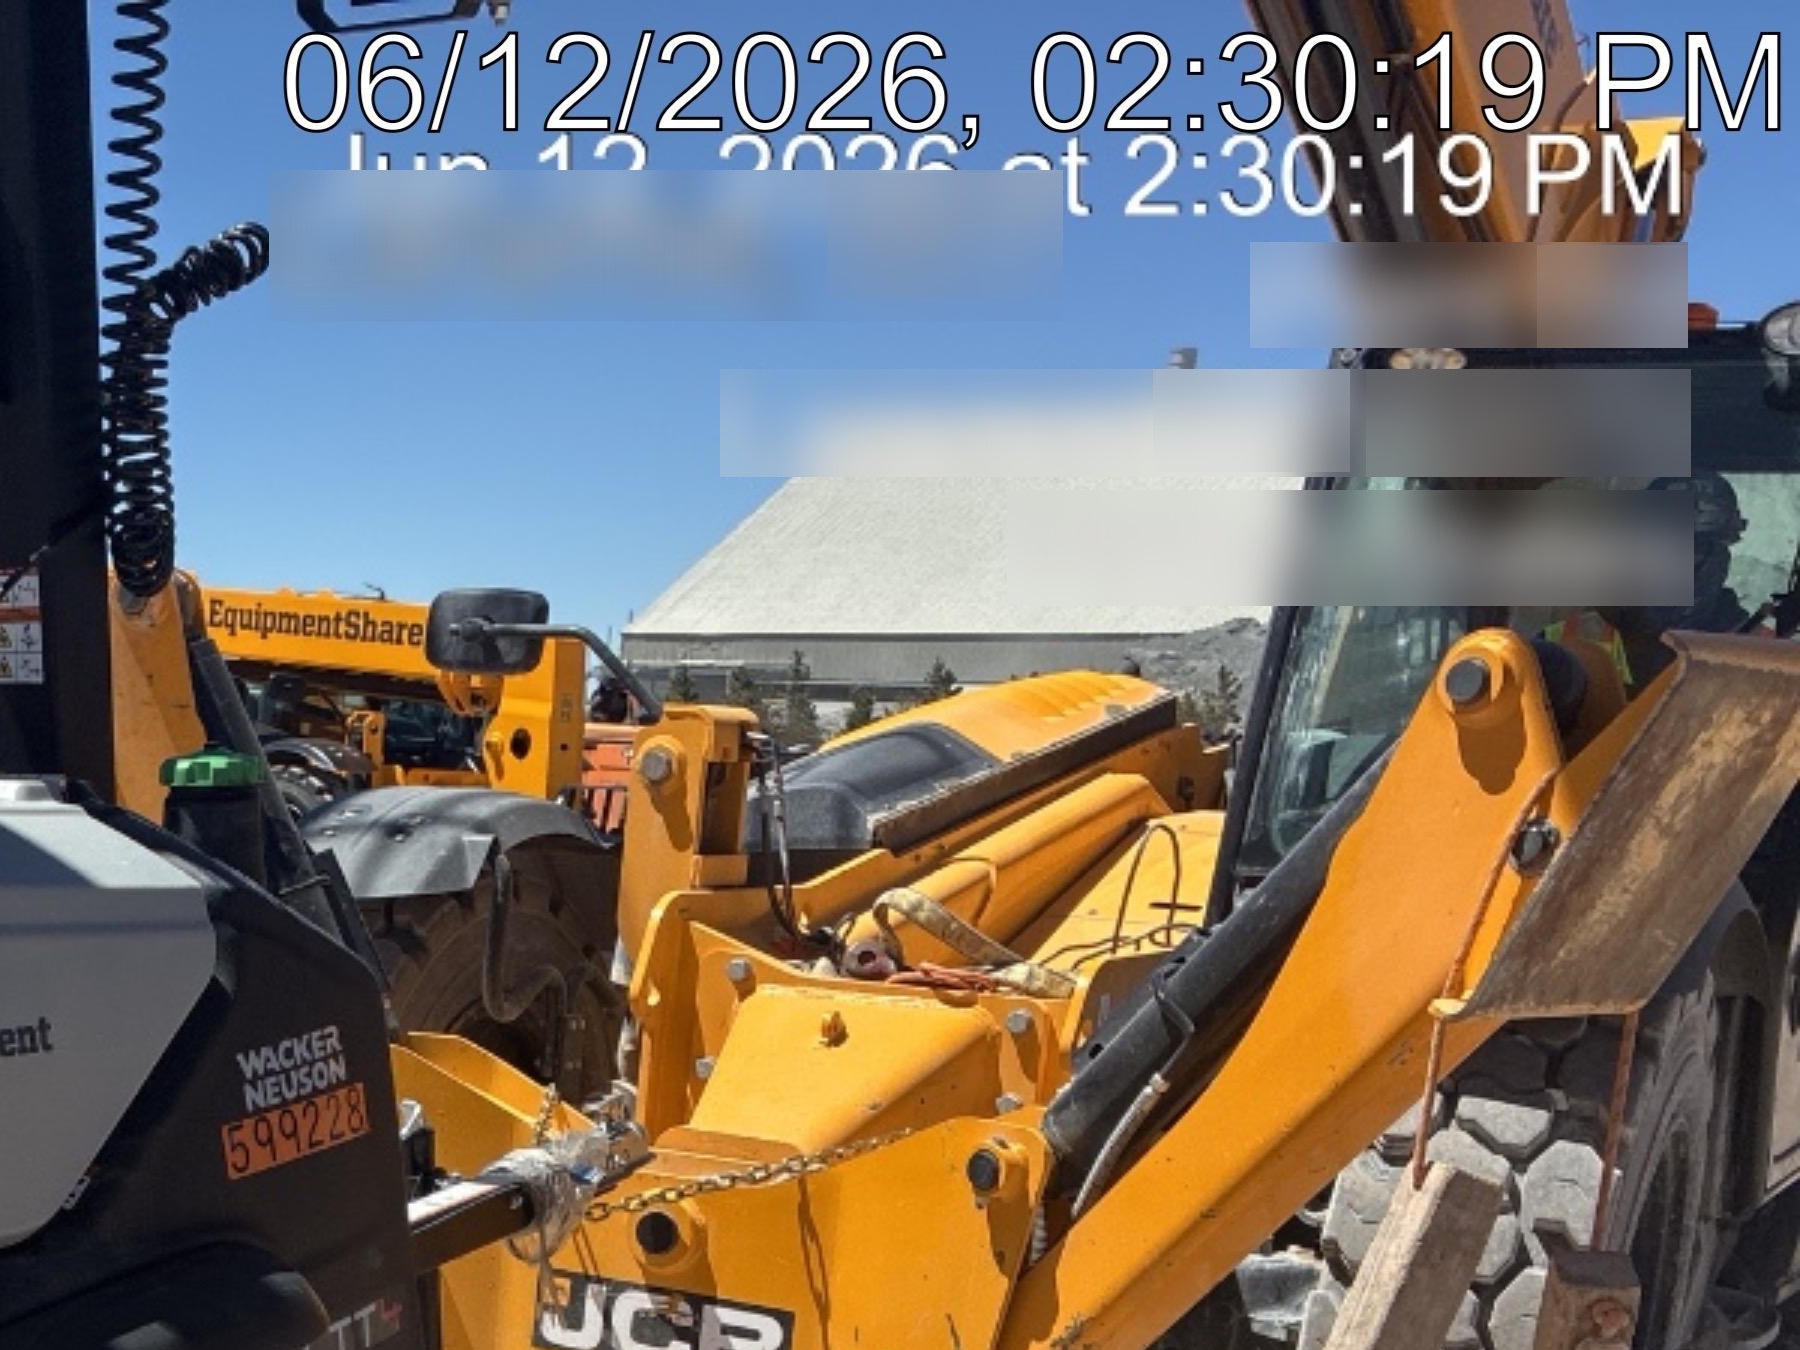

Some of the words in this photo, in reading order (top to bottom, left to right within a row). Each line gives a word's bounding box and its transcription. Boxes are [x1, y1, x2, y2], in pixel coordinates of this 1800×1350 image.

[208, 598, 423, 646] EquipmentShare
[236, 1025, 342, 1079] WACKER
[243, 1054, 347, 1112] NEUSON
[227, 1088, 364, 1173] 599228
